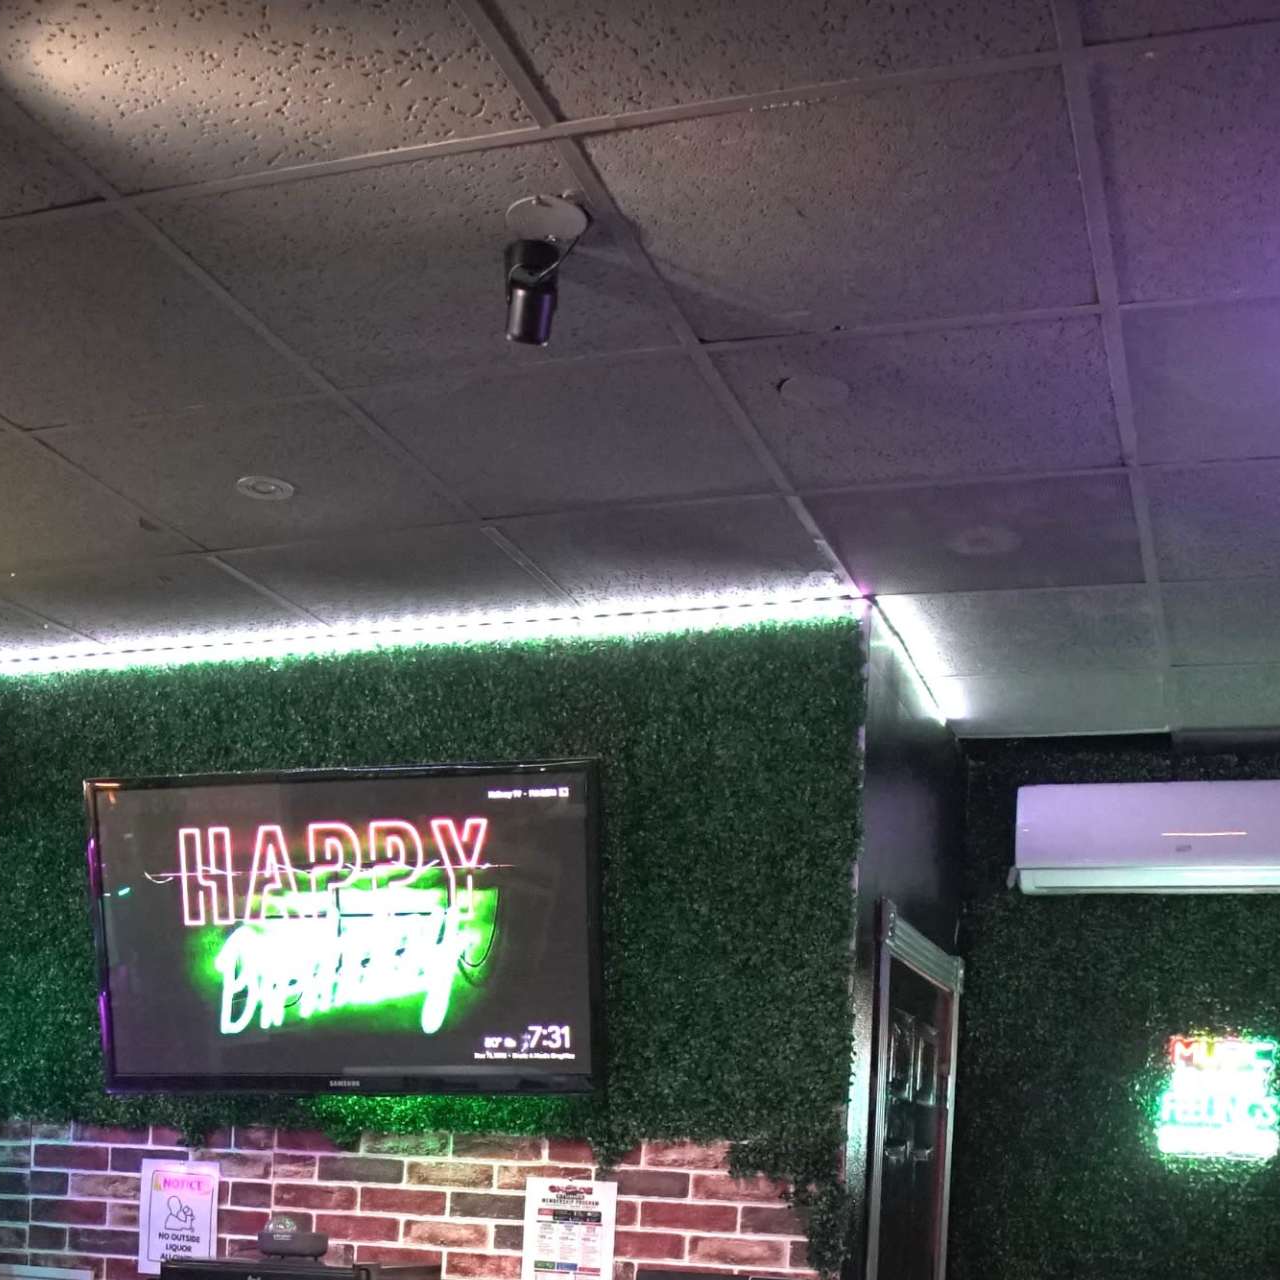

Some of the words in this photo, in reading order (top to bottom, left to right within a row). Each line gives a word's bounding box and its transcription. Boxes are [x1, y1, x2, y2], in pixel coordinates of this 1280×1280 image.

[178, 818, 488, 926] HAPPY
[528, 1025, 570, 1049] 7:31
[162, 1177, 203, 1192] NOTICE
[158, 1231, 170, 1241] NO
[170, 1233, 201, 1244] OUTSIDE
[165, 1243, 193, 1254] LIQUOR
